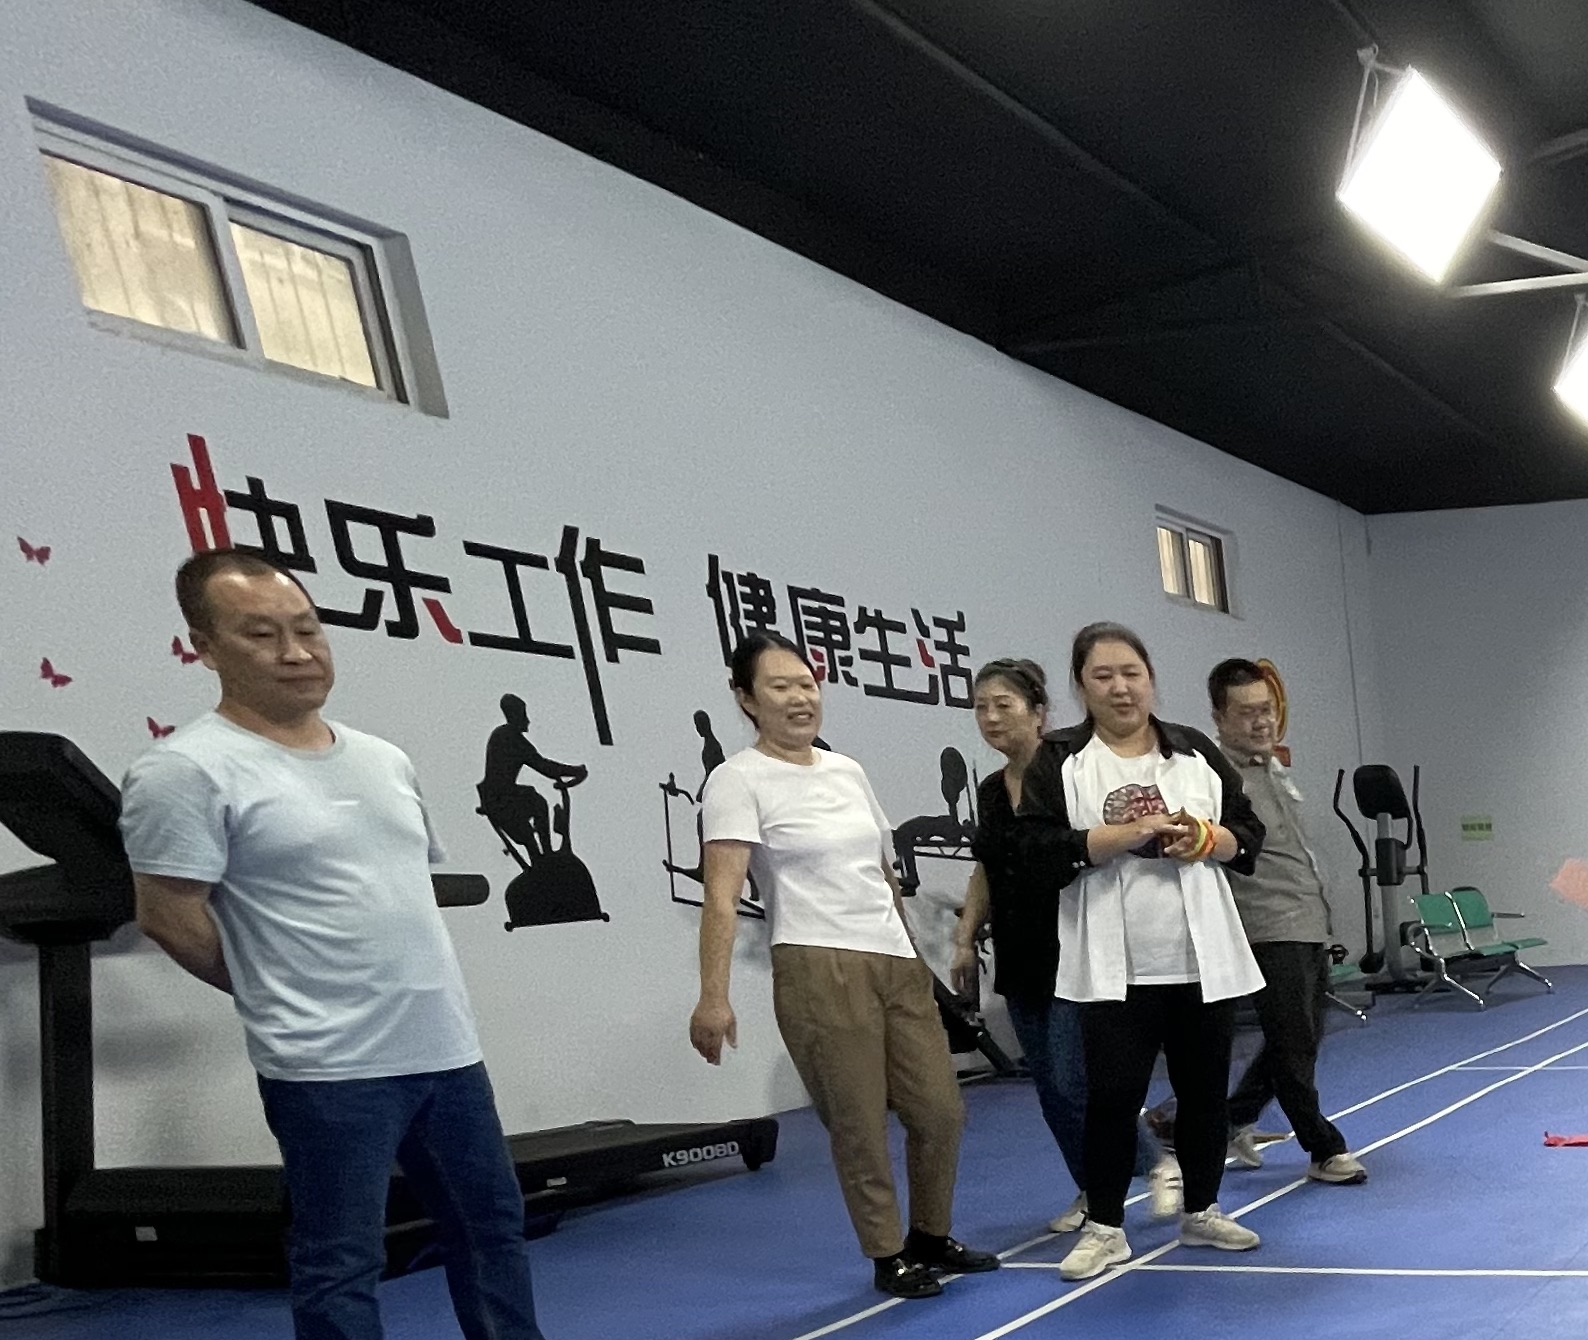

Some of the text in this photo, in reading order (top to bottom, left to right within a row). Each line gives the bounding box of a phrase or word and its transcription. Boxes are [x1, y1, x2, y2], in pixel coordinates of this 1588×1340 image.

[171, 432, 974, 747] 快乐工作 健康生活
